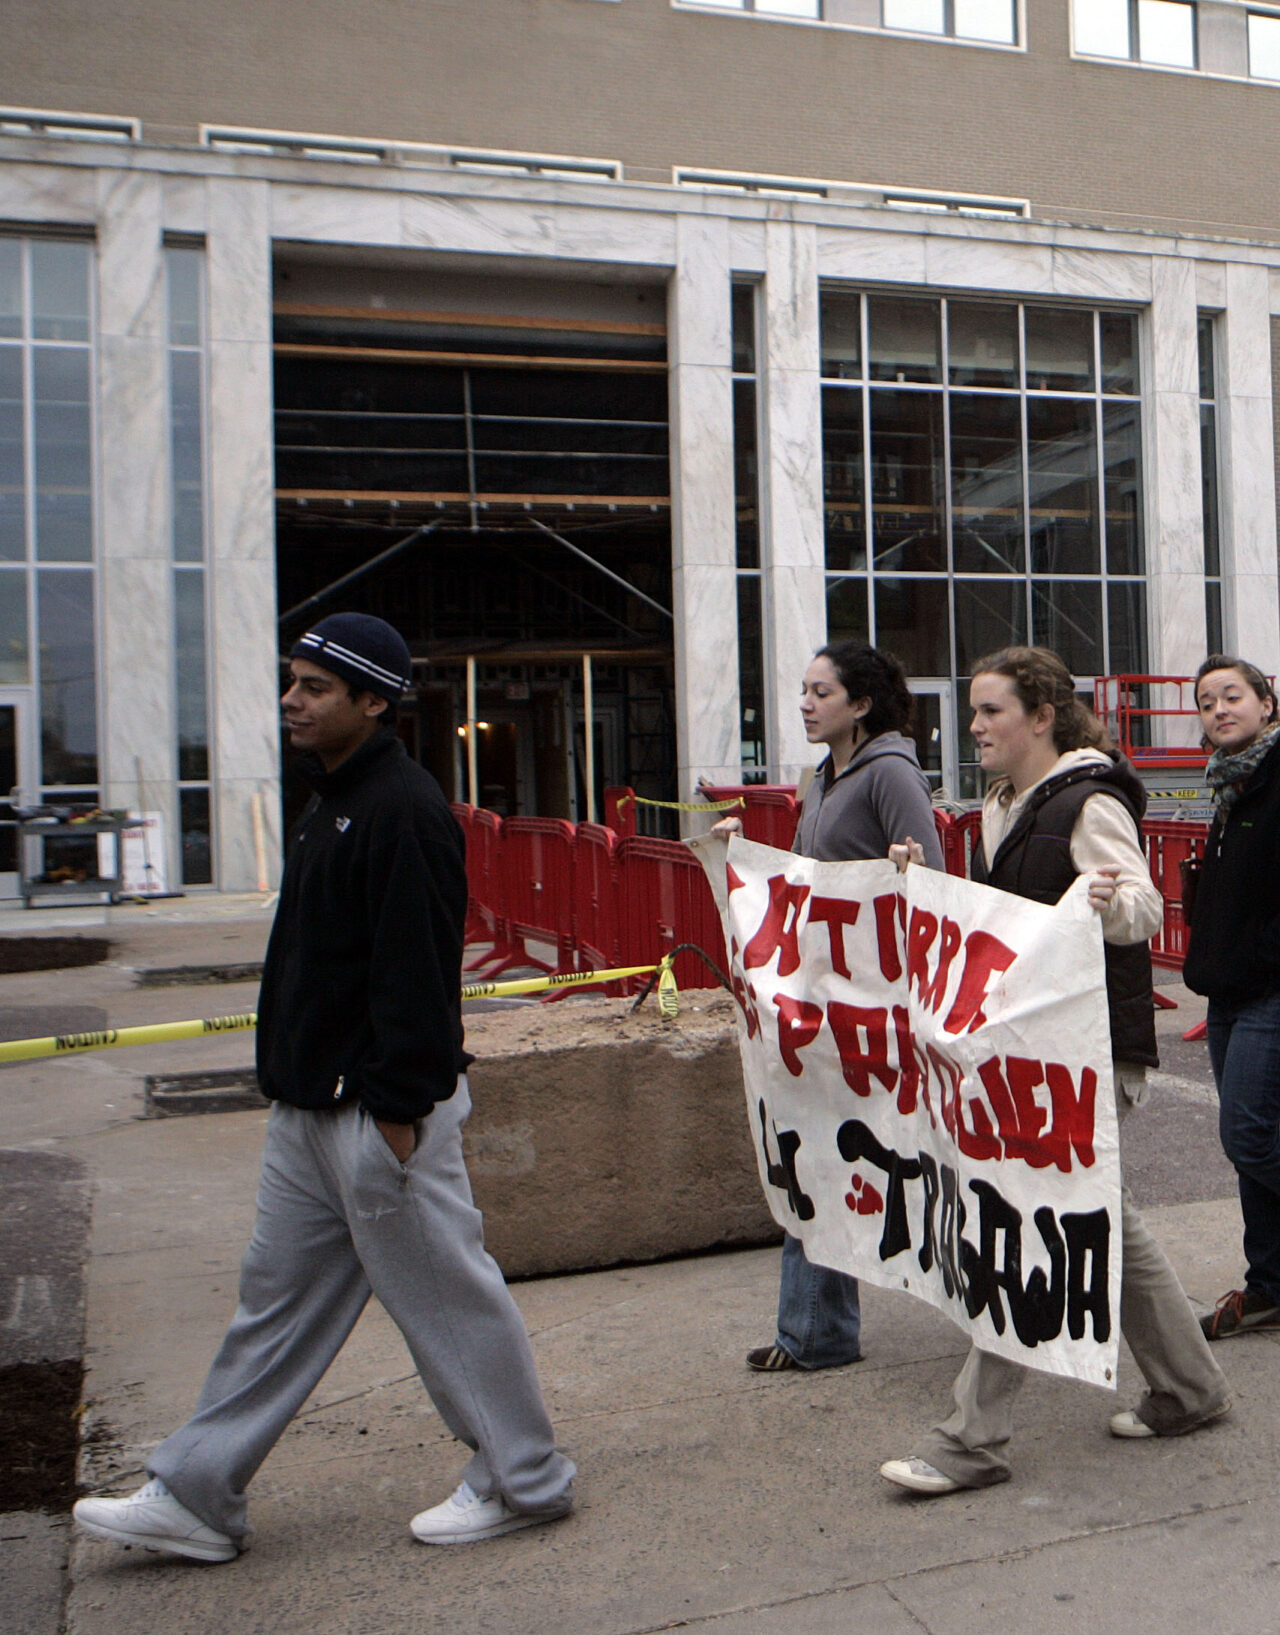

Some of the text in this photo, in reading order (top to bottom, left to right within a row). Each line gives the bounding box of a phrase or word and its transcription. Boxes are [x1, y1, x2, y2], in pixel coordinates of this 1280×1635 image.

[1177, 789, 1196, 798] KEEP
[55, 1030, 118, 1050] CAUTION
[837, 1118, 1112, 1348] TRABAJA
